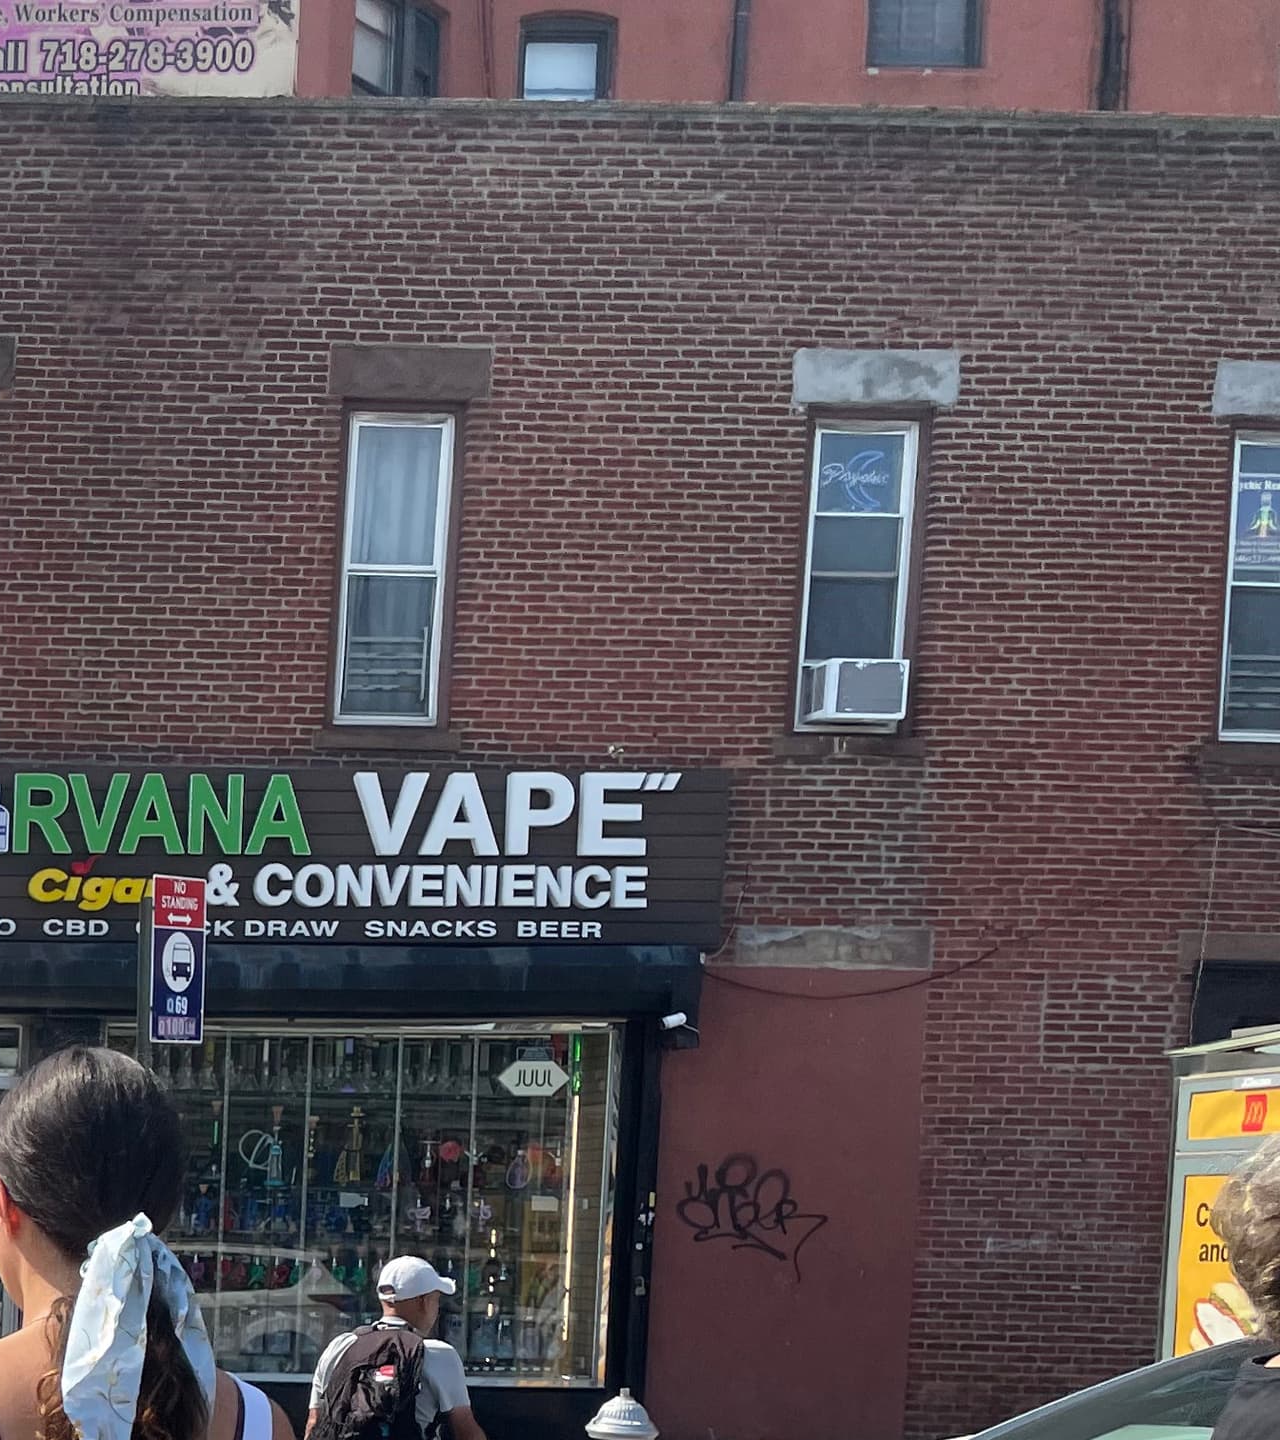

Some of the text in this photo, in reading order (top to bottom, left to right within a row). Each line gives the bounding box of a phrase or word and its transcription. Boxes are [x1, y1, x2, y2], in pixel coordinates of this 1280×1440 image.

[40, 39, 255, 73] 718-278-3900
[173, 880, 187, 894] NO
[206, 863, 240, 908] &
[253, 862, 649, 909] CONVENIENCE
[161, 894, 199, 911] STANDING
[42, 918, 110, 937] CBD
[244, 919, 340, 938] DRAW
[364, 920, 498, 938] SNACKS
[516, 920, 603, 939] BEER
[515, 1068, 554, 1088] JUUL
